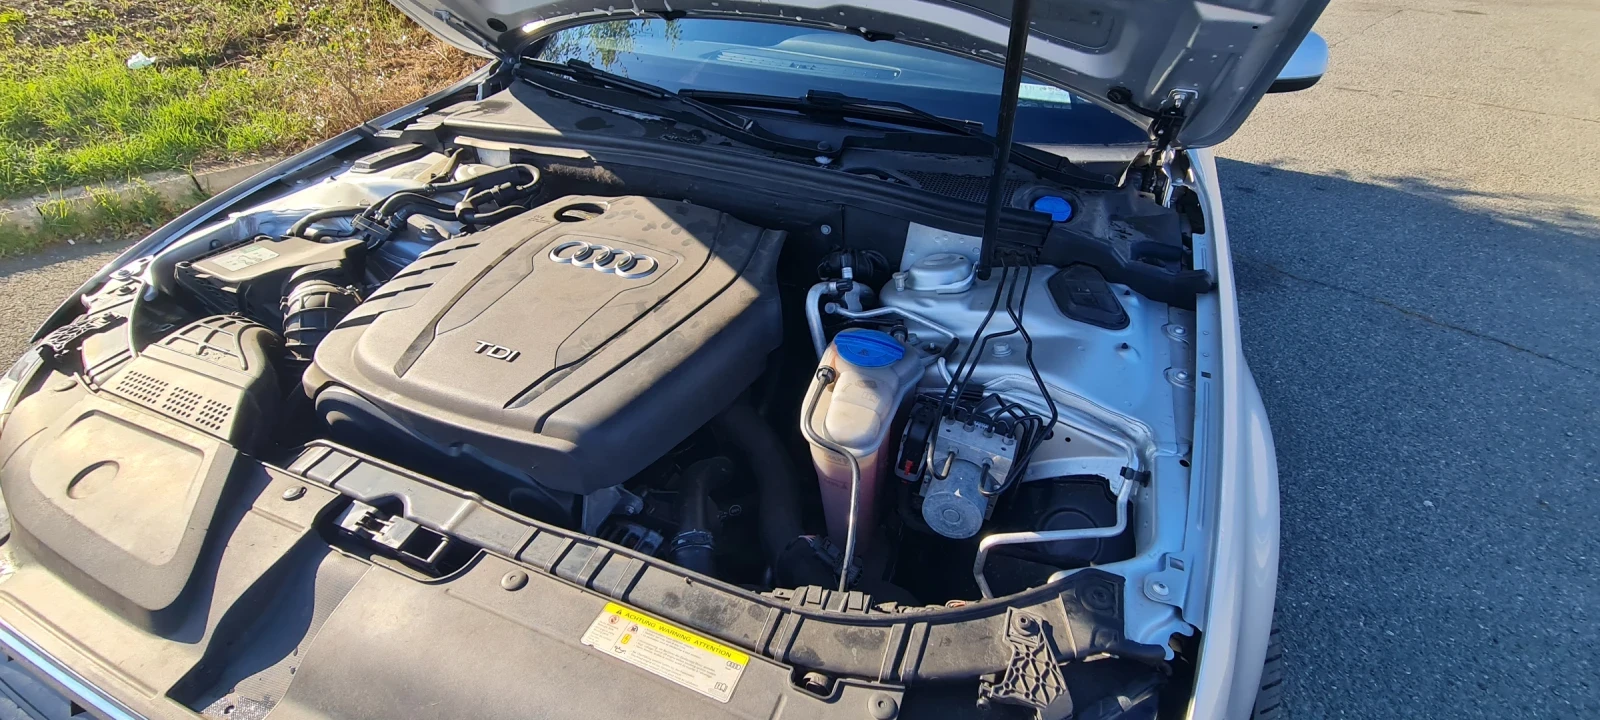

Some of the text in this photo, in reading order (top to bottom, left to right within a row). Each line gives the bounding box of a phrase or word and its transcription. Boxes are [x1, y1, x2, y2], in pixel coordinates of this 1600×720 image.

[475, 340, 521, 362] TDI
[625, 612, 656, 628] ACHTUNG
[659, 625, 692, 642] WARNING
[694, 640, 732, 658] ATTENTION
